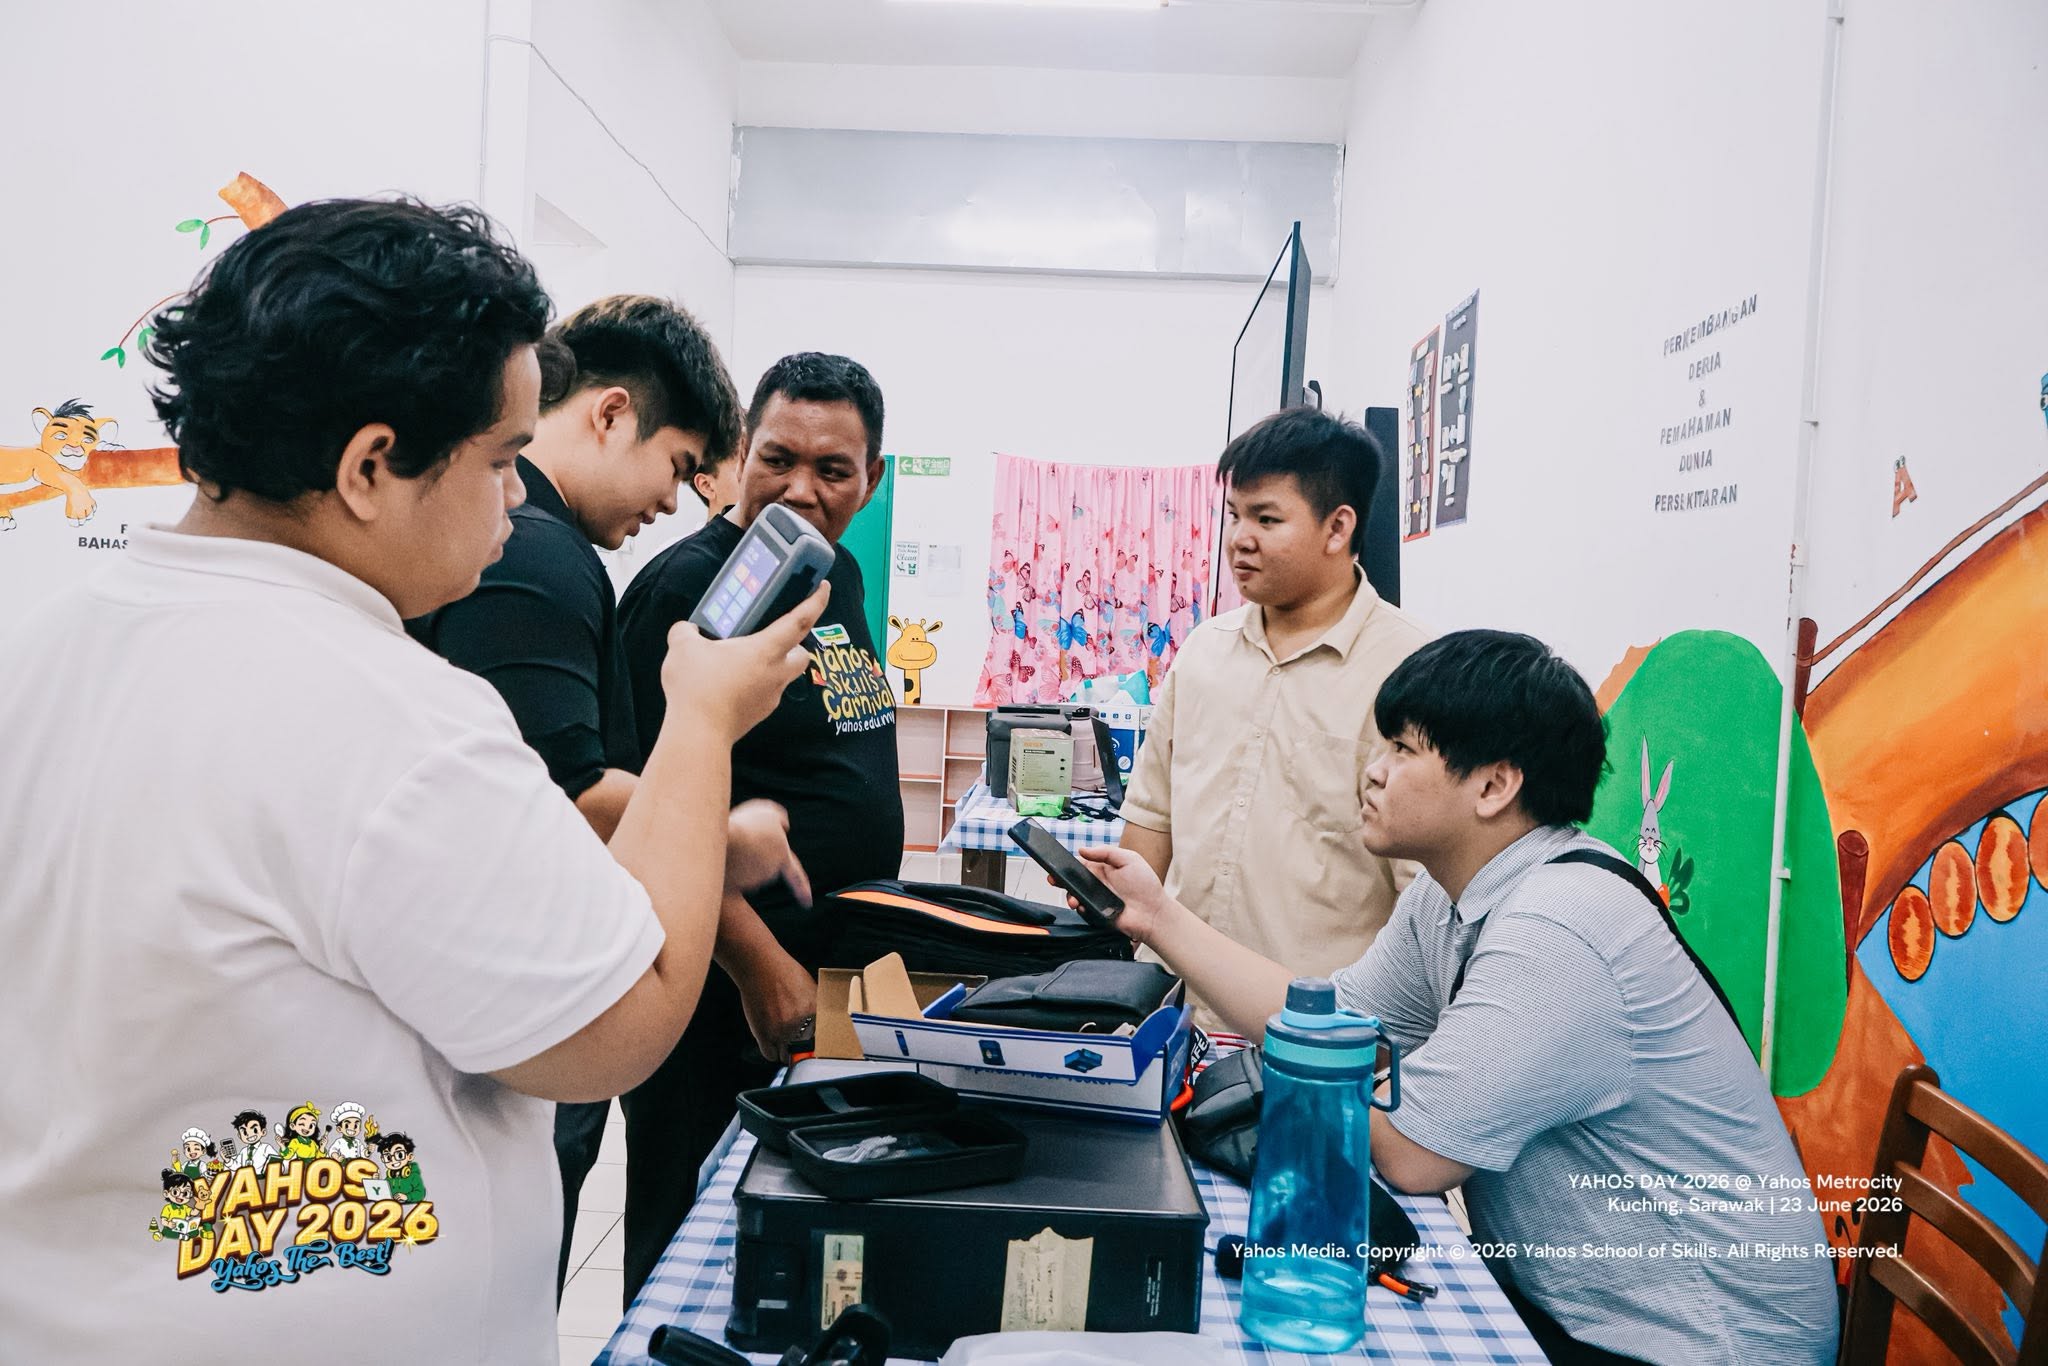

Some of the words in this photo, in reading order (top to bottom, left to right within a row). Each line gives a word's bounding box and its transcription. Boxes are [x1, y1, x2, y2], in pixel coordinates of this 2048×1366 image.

[1663, 293, 1758, 357] PERKEMBANGAN
[1688, 351, 1721, 380] DERIA
[1698, 389, 1705, 407] &
[1660, 407, 1732, 445] PEMAHAMAN
[1679, 448, 1713, 473] DUNIA
[1654, 483, 1738, 512] PERSEKITARAN
[896, 553, 917, 561] Clean
[822, 678, 897, 721] Carnival
